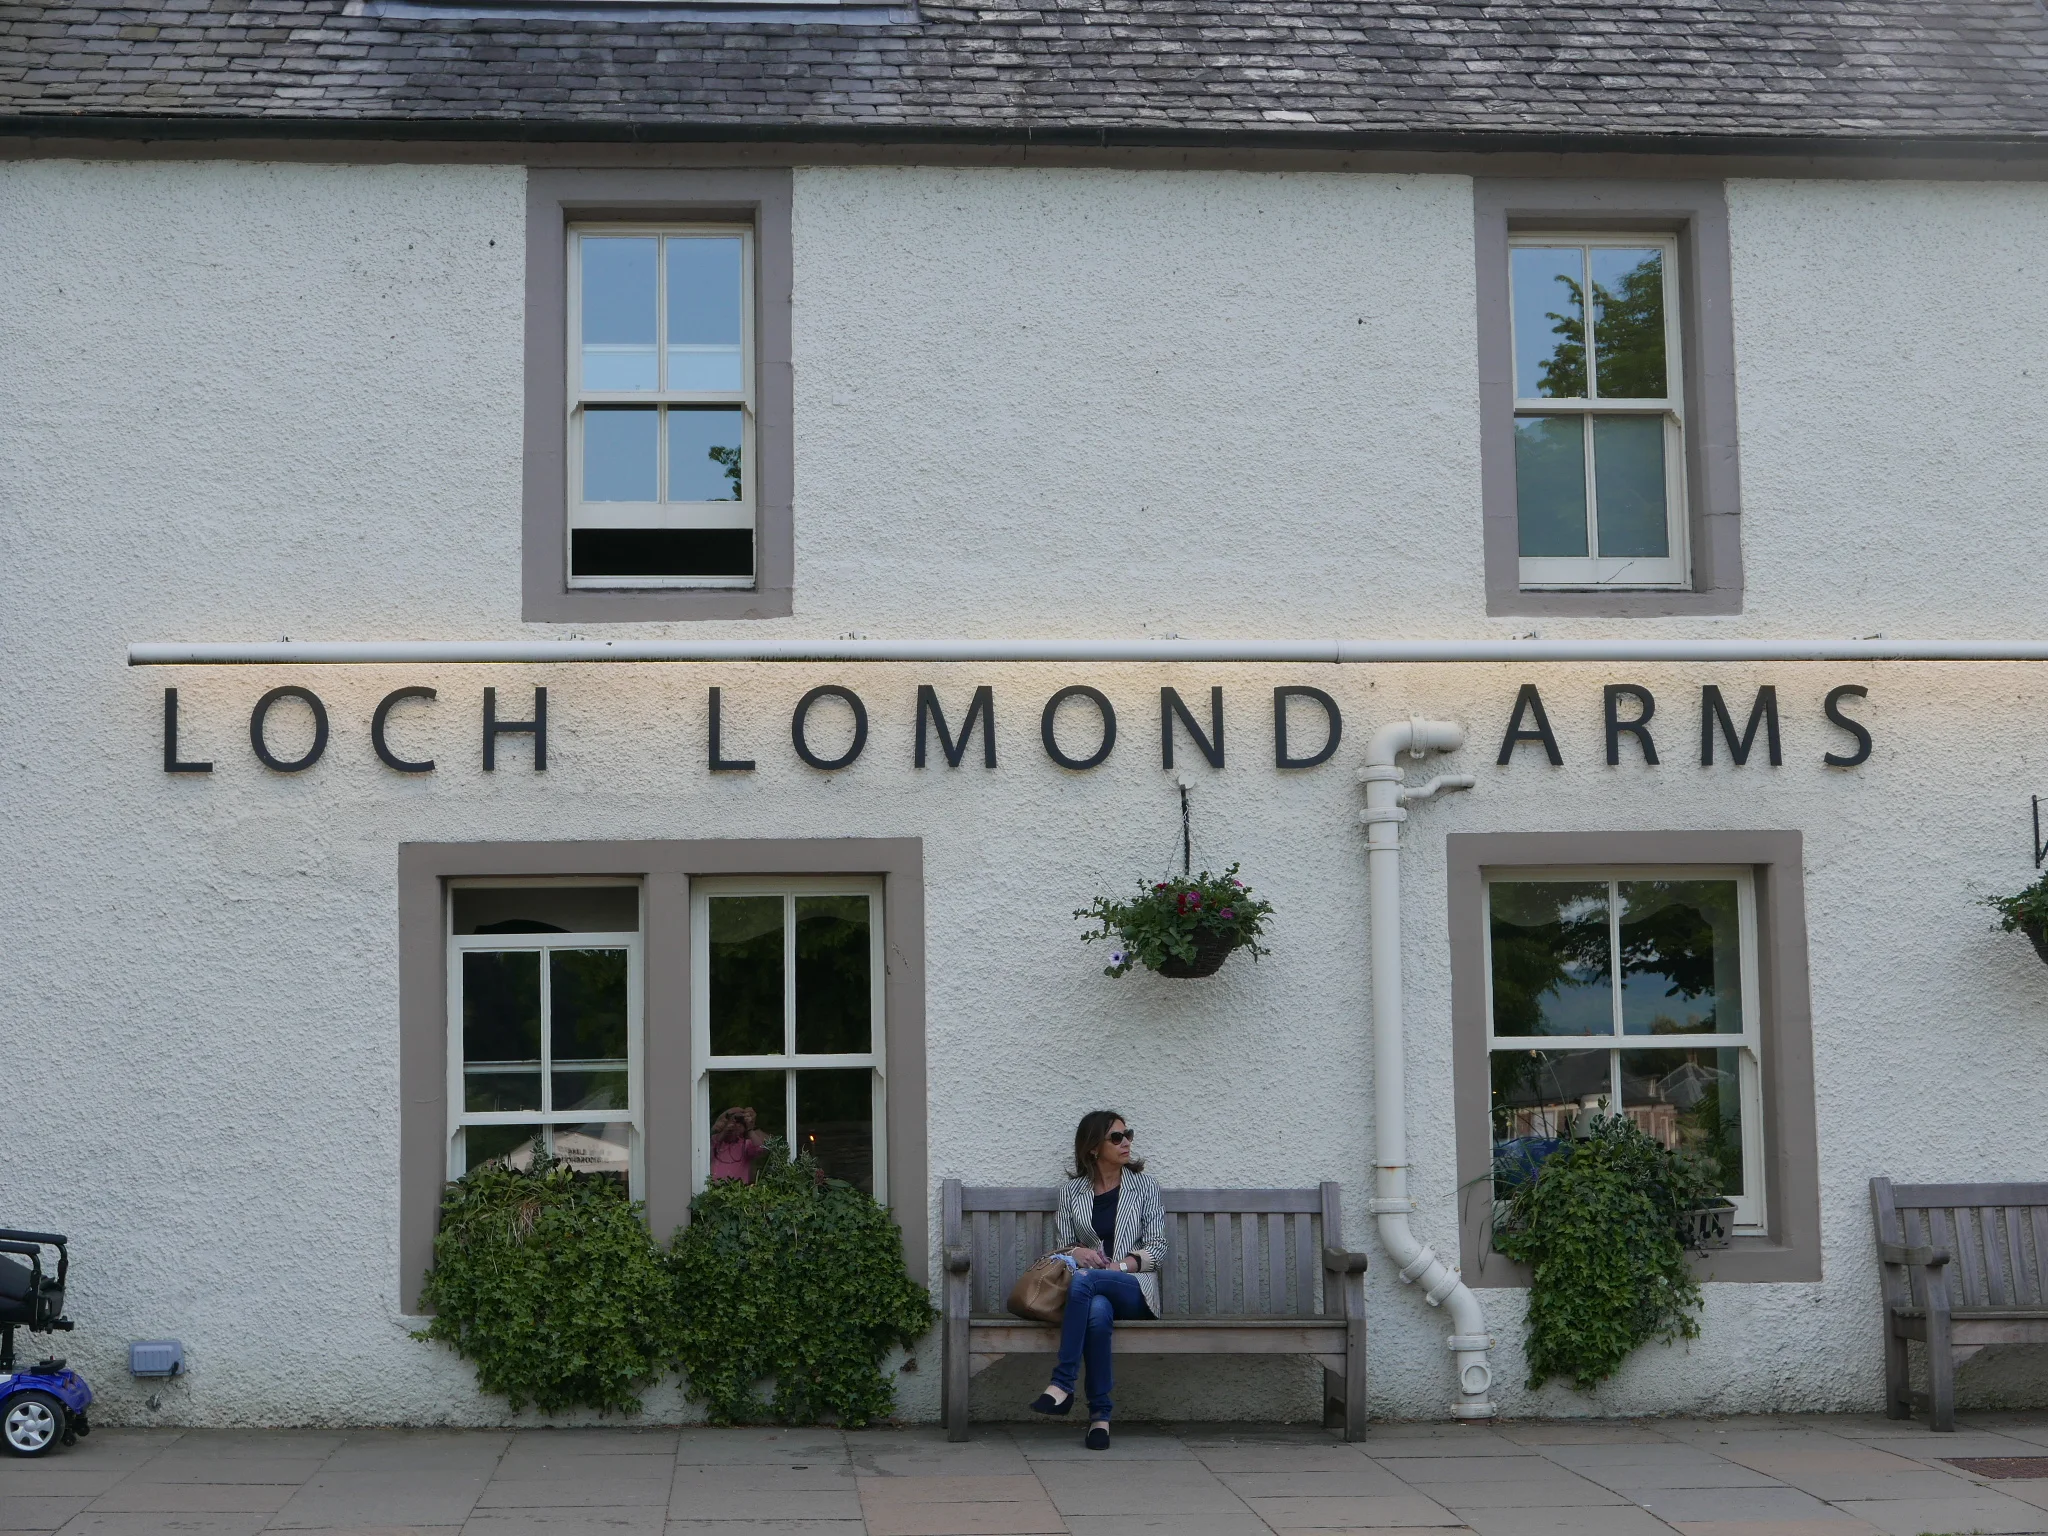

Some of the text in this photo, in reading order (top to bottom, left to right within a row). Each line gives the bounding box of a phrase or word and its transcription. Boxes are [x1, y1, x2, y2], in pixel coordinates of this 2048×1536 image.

[164, 684, 1873, 775] LOCH LOMOND ARMS
